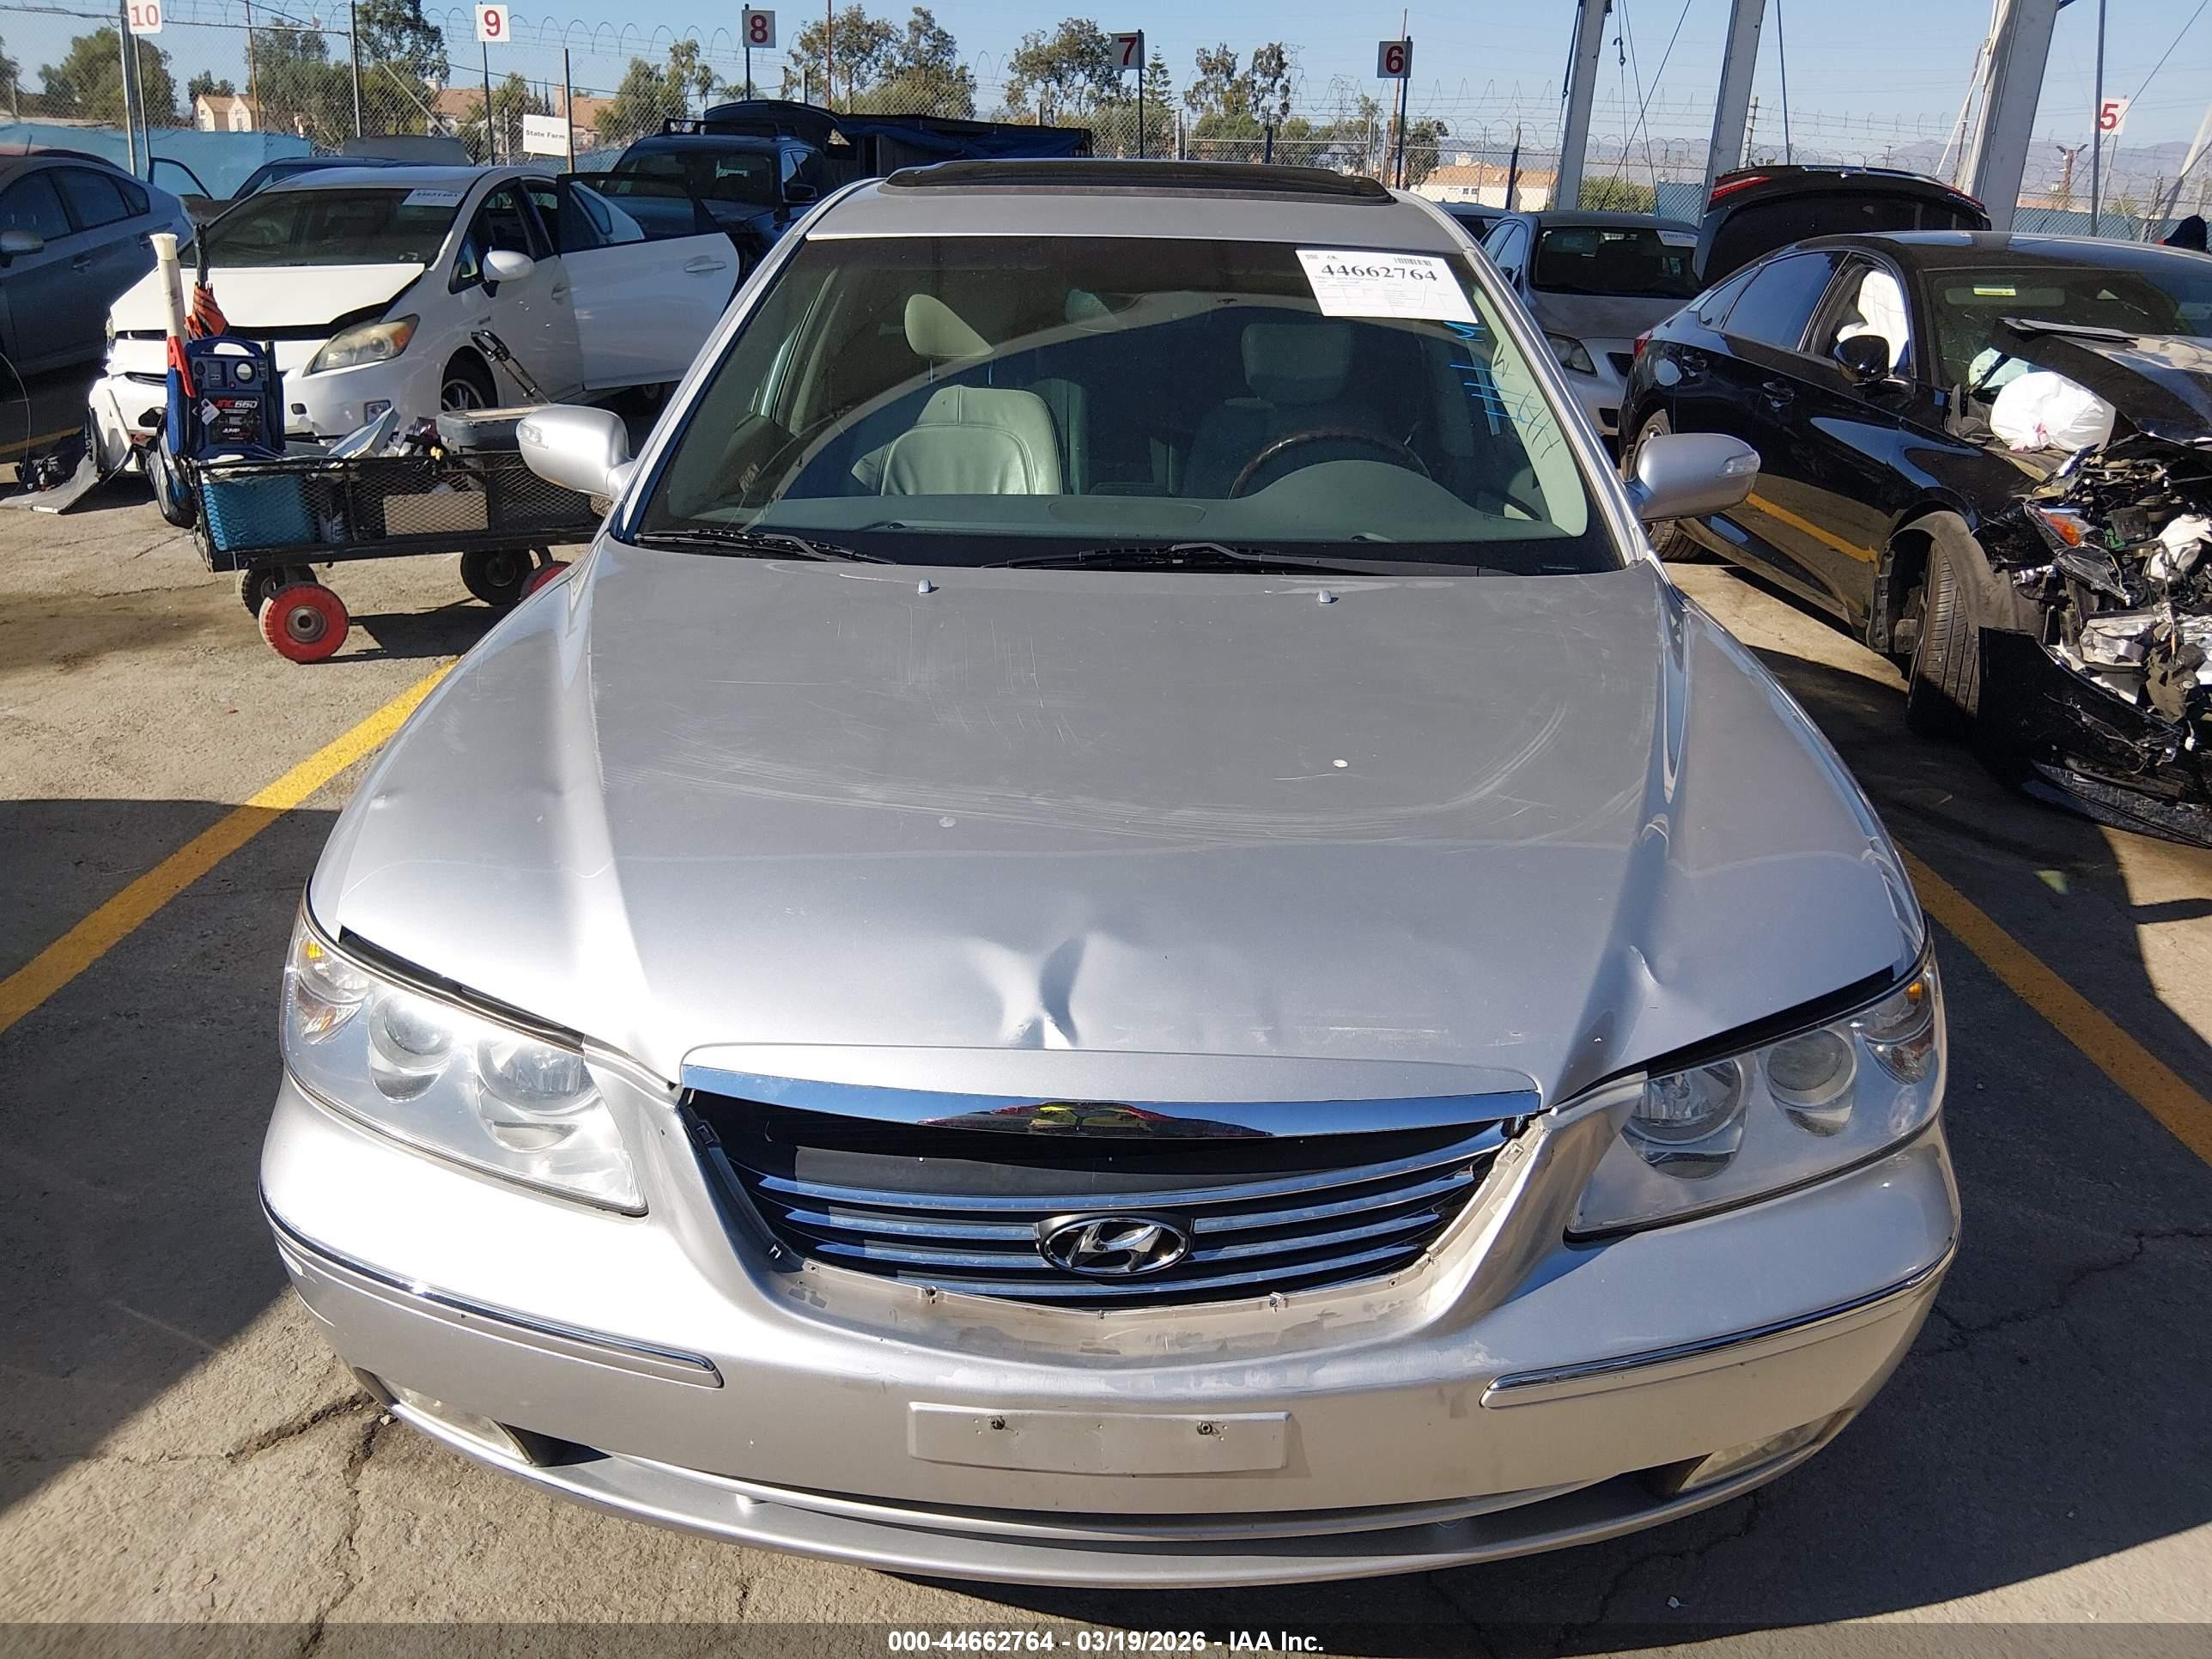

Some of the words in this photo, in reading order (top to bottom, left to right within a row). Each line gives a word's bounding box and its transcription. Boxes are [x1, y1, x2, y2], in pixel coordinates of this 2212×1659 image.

[131, 4, 159, 27] 10
[483, 9, 501, 37] 9
[750, 14, 769, 43] 8
[1118, 36, 1137, 66] 7
[1385, 45, 1404, 74] 6
[2099, 103, 2118, 130] 5
[526, 129, 545, 137] State
[1321, 264, 1438, 282] 44662764
